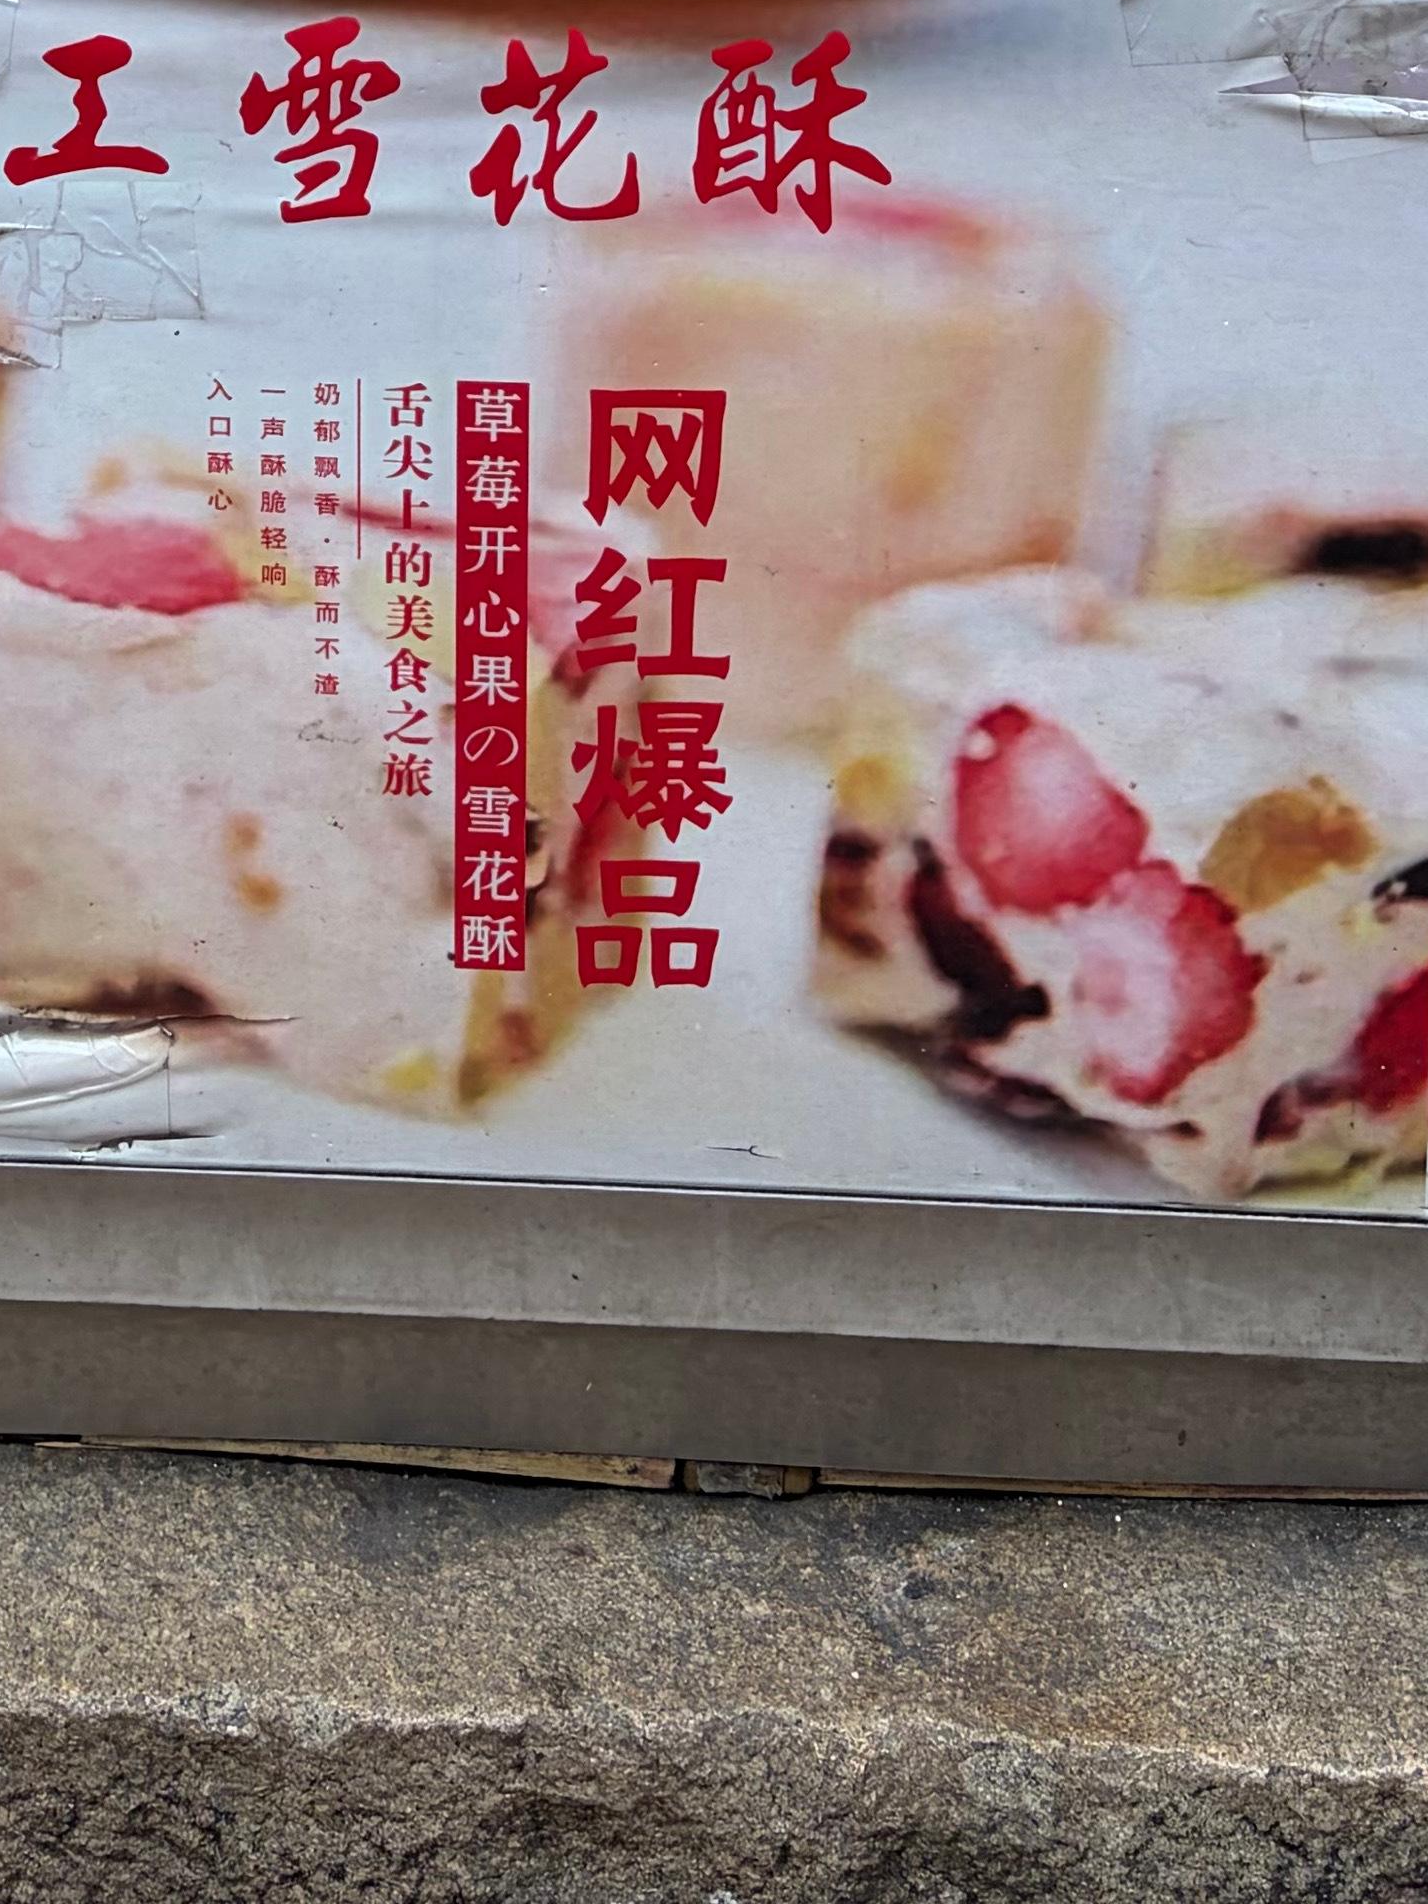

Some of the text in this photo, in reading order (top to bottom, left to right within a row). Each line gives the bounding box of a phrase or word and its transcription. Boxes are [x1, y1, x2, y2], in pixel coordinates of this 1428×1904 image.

[206, 377, 233, 512] 入口酥心
[260, 387, 288, 587] 一声酥脆轻响
[381, 381, 433, 797] 舌尖上的美食之旅
[461, 388, 522, 965] 草莓开心果の雪花酥
[571, 387, 734, 989] 网红爆品
